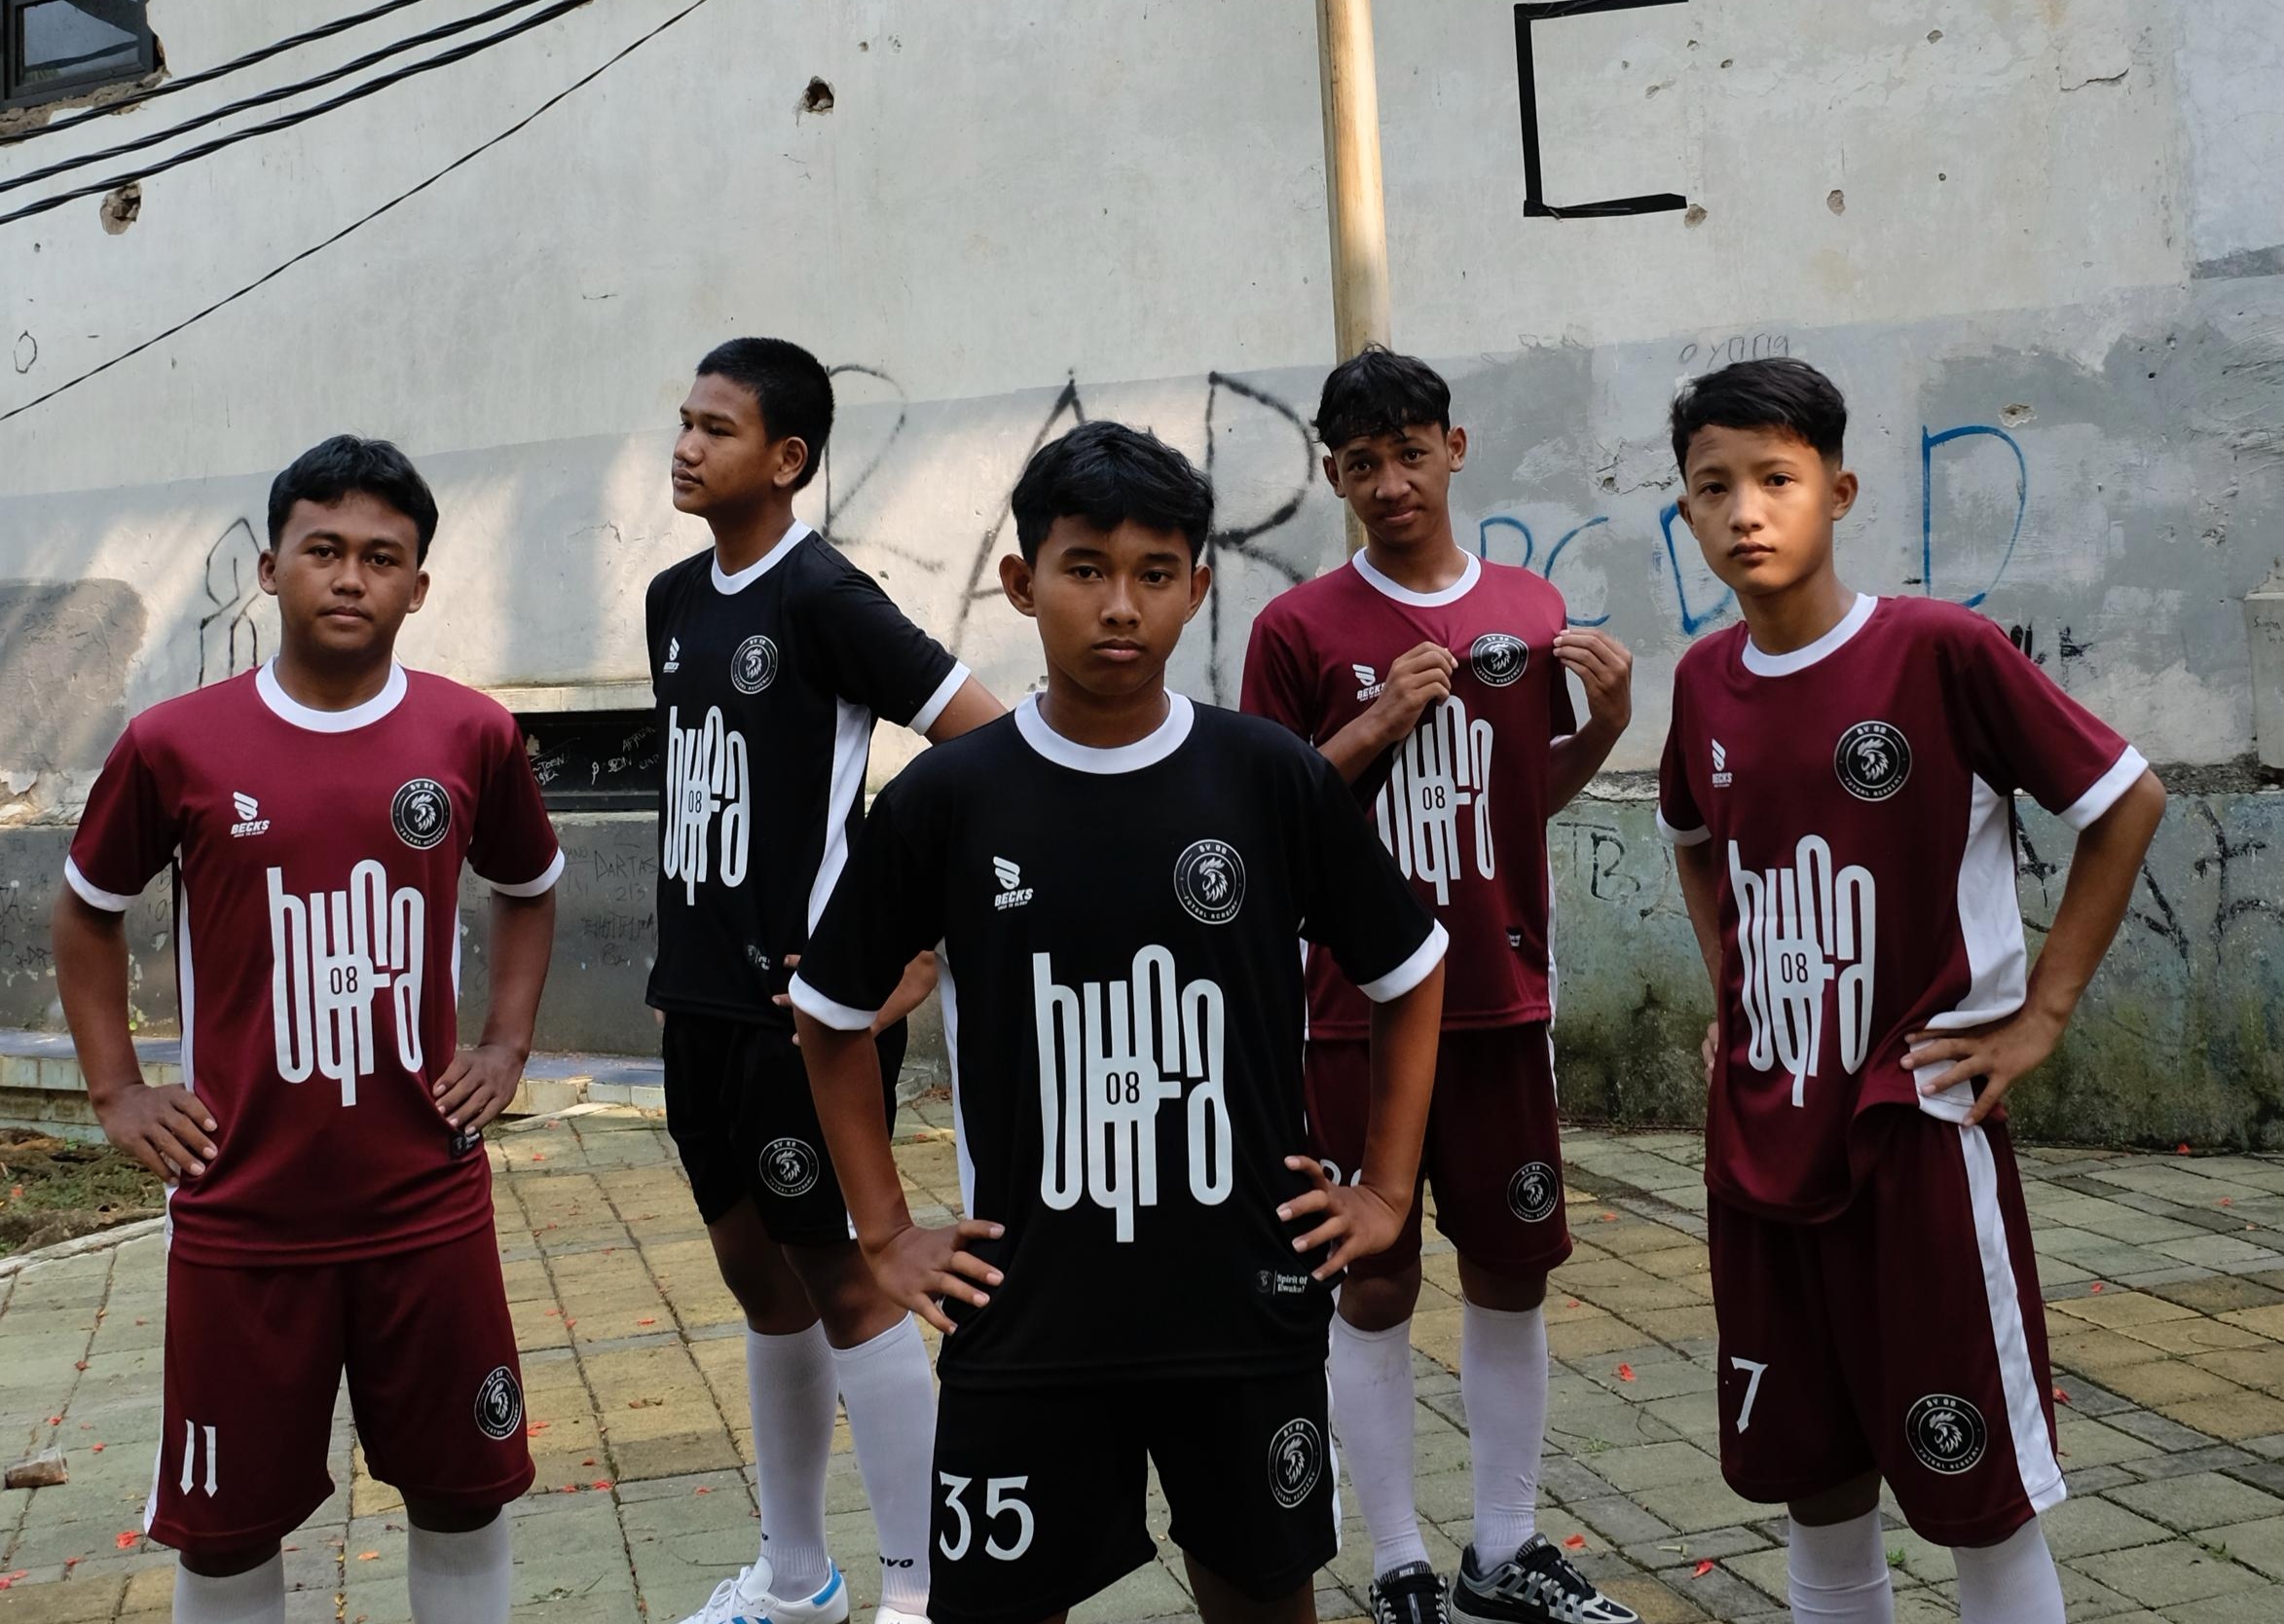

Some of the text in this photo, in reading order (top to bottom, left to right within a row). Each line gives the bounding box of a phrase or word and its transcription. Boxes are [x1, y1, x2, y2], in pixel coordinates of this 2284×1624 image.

[688, 790, 702, 814] 08
[1422, 786, 1446, 810] 08
[231, 820, 270, 834] BECKS
[994, 888, 1034, 906] BECKS
[330, 966, 358, 995] 08
[1781, 952, 1808, 983] 08
[1106, 1071, 1140, 1105] 08
[1731, 1356, 1769, 1434] 7
[179, 1419, 218, 1498] 11
[939, 1470, 1034, 1561] 35
